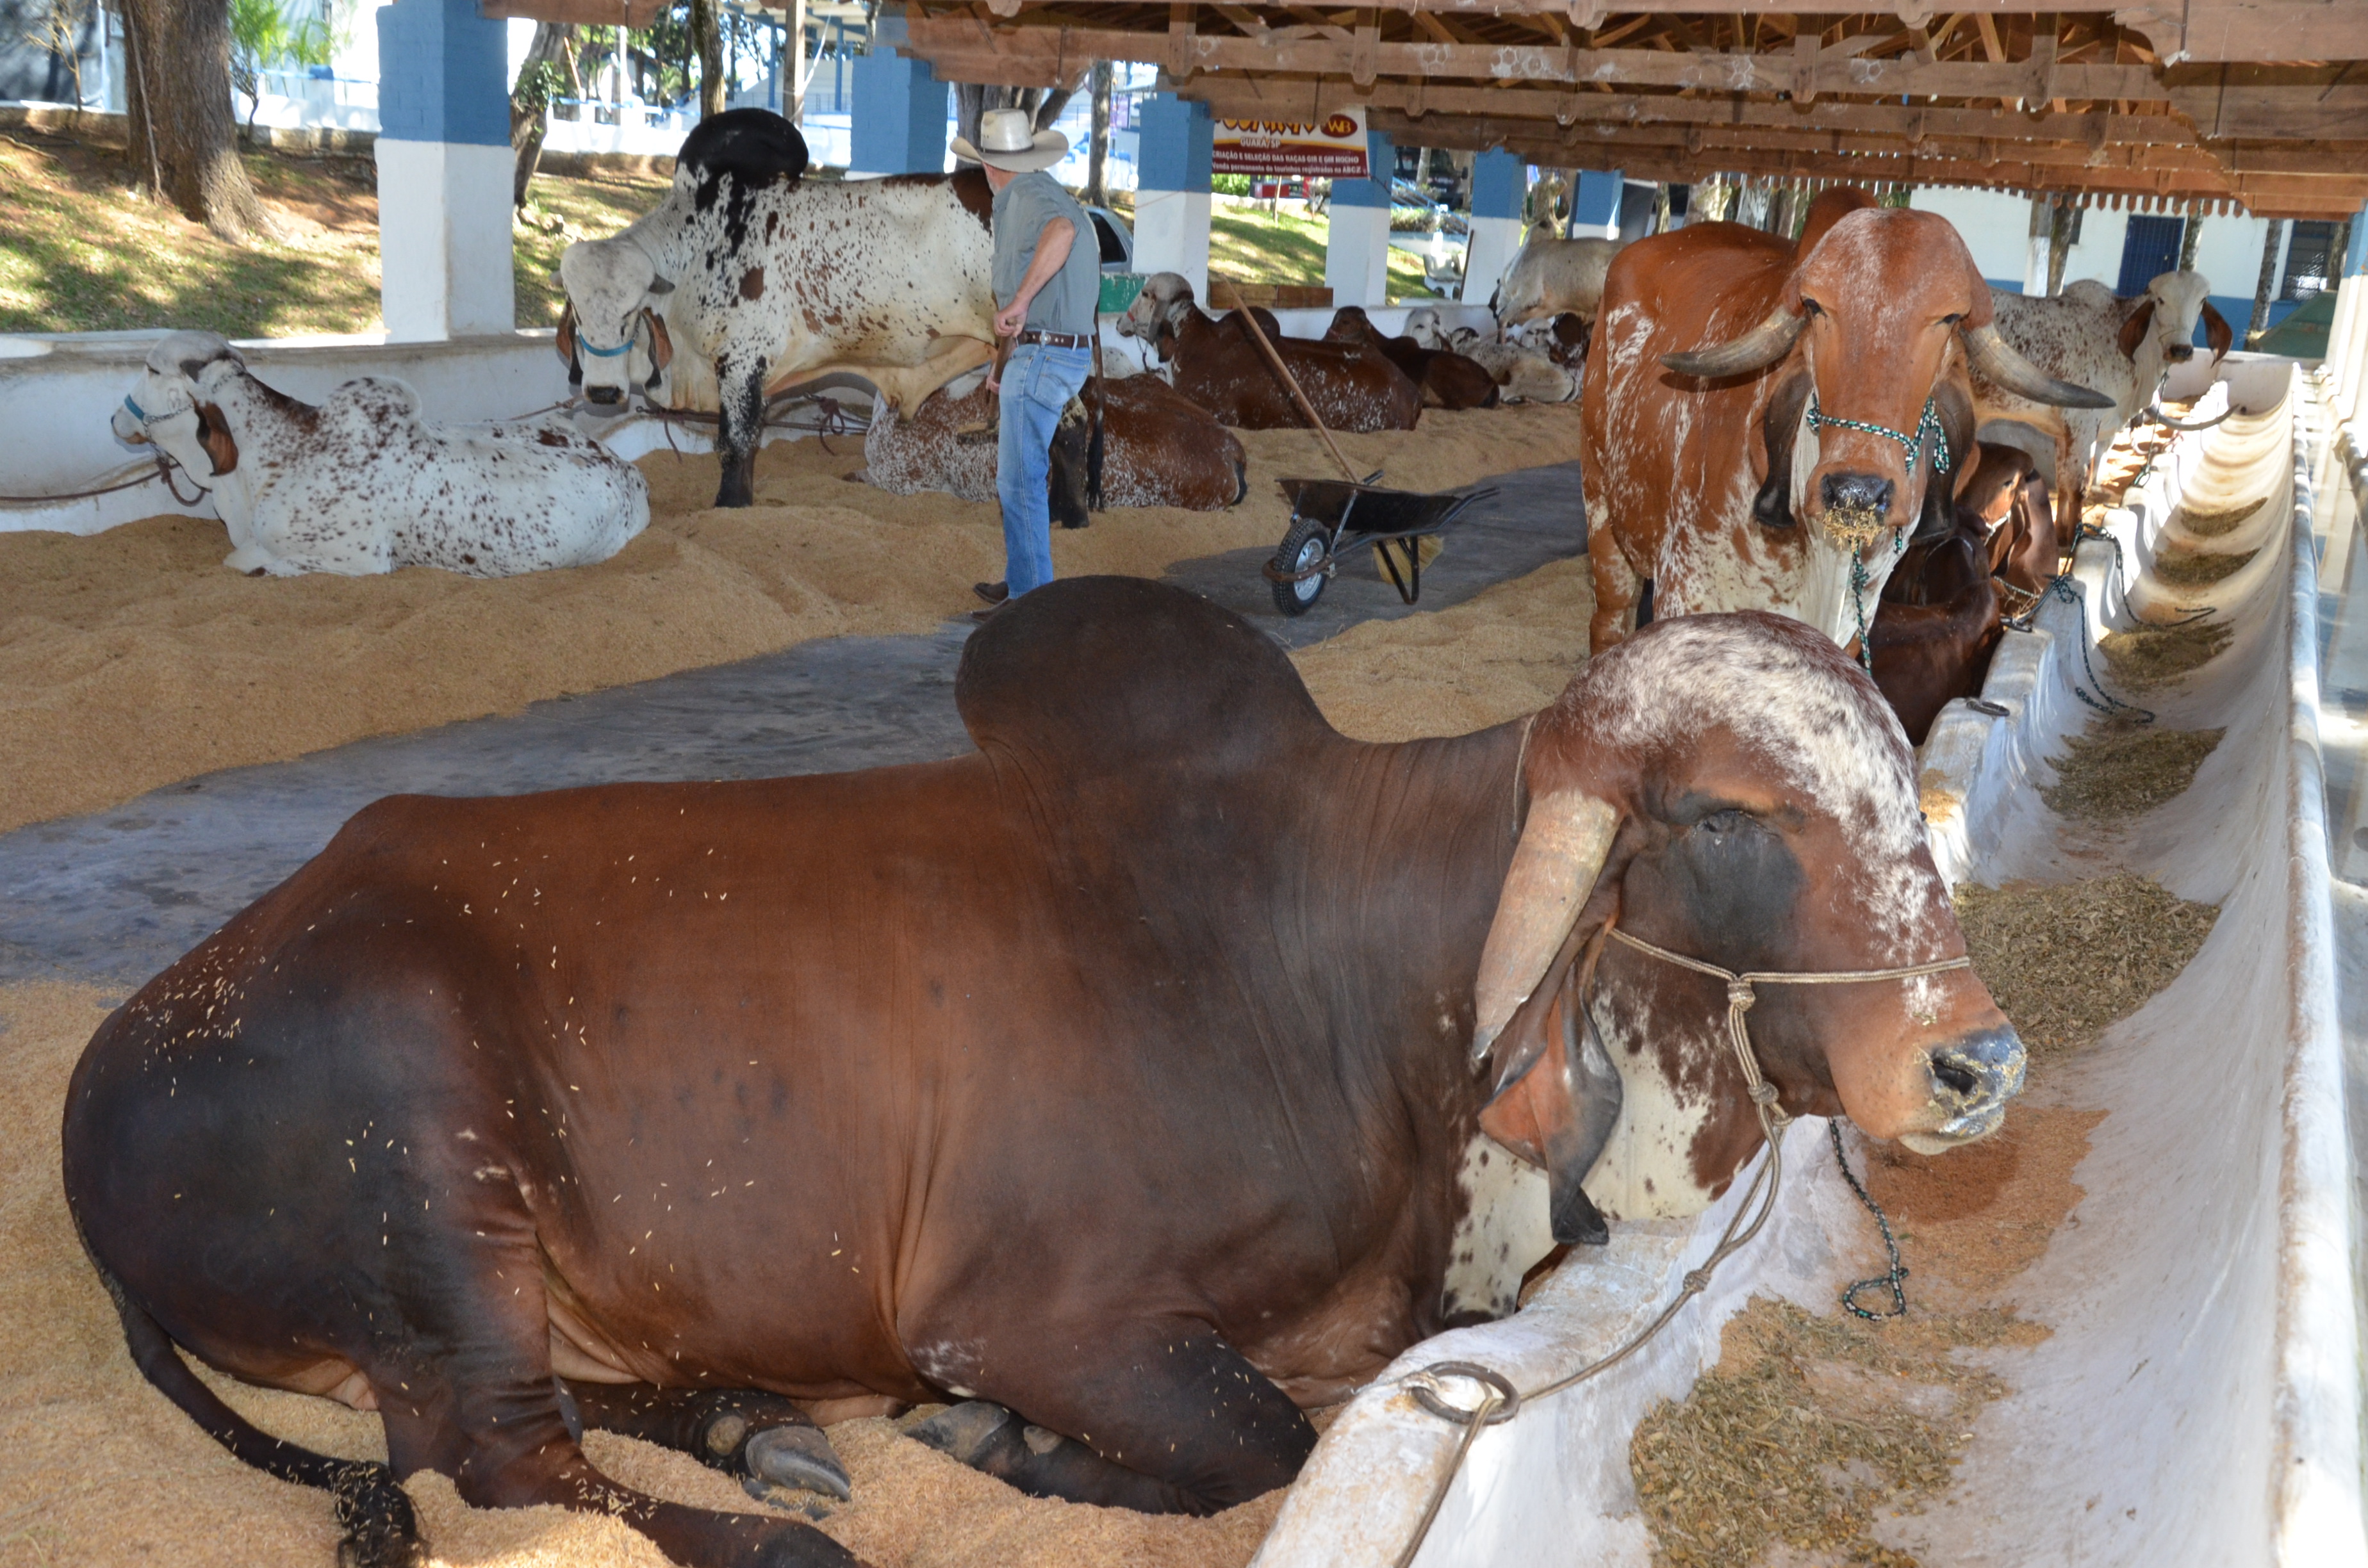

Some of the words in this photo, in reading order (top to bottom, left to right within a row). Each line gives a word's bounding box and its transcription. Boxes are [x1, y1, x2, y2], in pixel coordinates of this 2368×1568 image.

[1240, 136, 1281, 148] GUARÁ/SP
[1212, 150, 1238, 160] CRIAÇÃO
[1244, 152, 1270, 162] SELEÇÃO
[1285, 155, 1305, 163] RAÇAS
[1212, 162, 1229, 170] Venda
[1342, 166, 1361, 174] ABCZ
